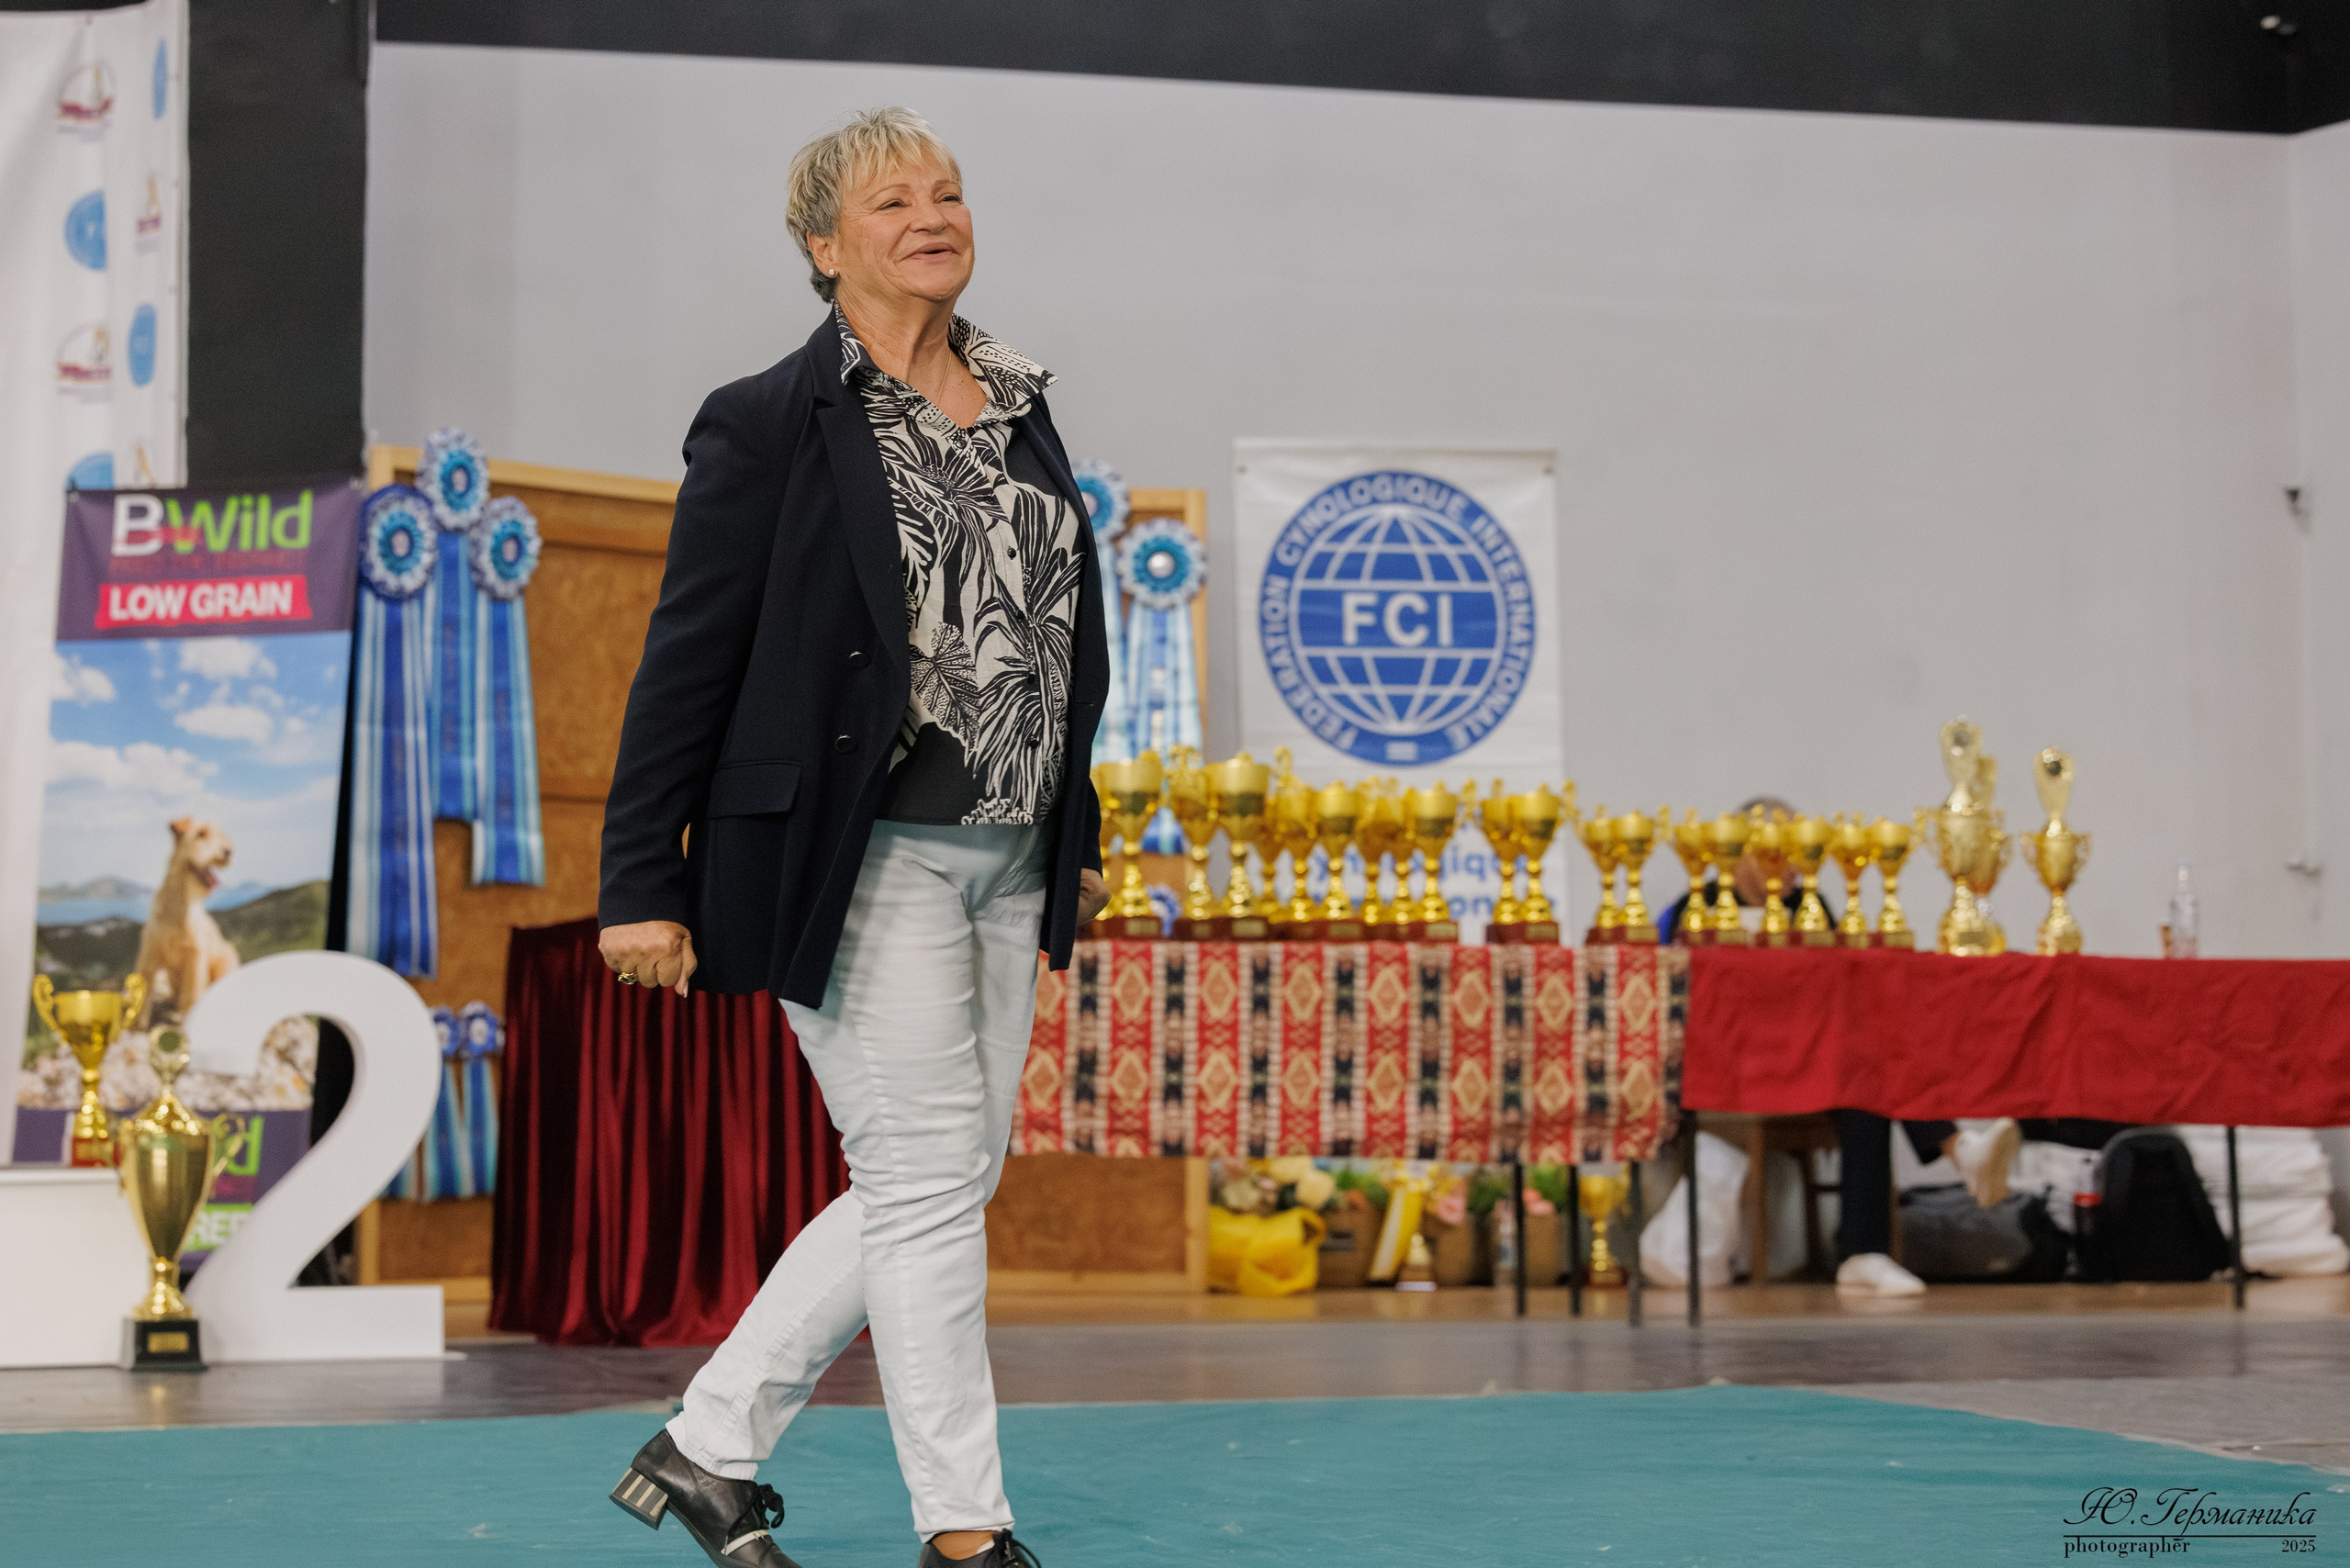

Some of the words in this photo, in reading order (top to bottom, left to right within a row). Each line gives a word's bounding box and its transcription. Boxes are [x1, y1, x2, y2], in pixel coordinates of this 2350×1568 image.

[1275, 472, 1472, 568] CYNOLOGIQUE
[108, 584, 186, 621] LOW
[188, 581, 293, 619] GRAIN
[1341, 591, 1455, 648] FCI
[184, 950, 445, 1366] 2
